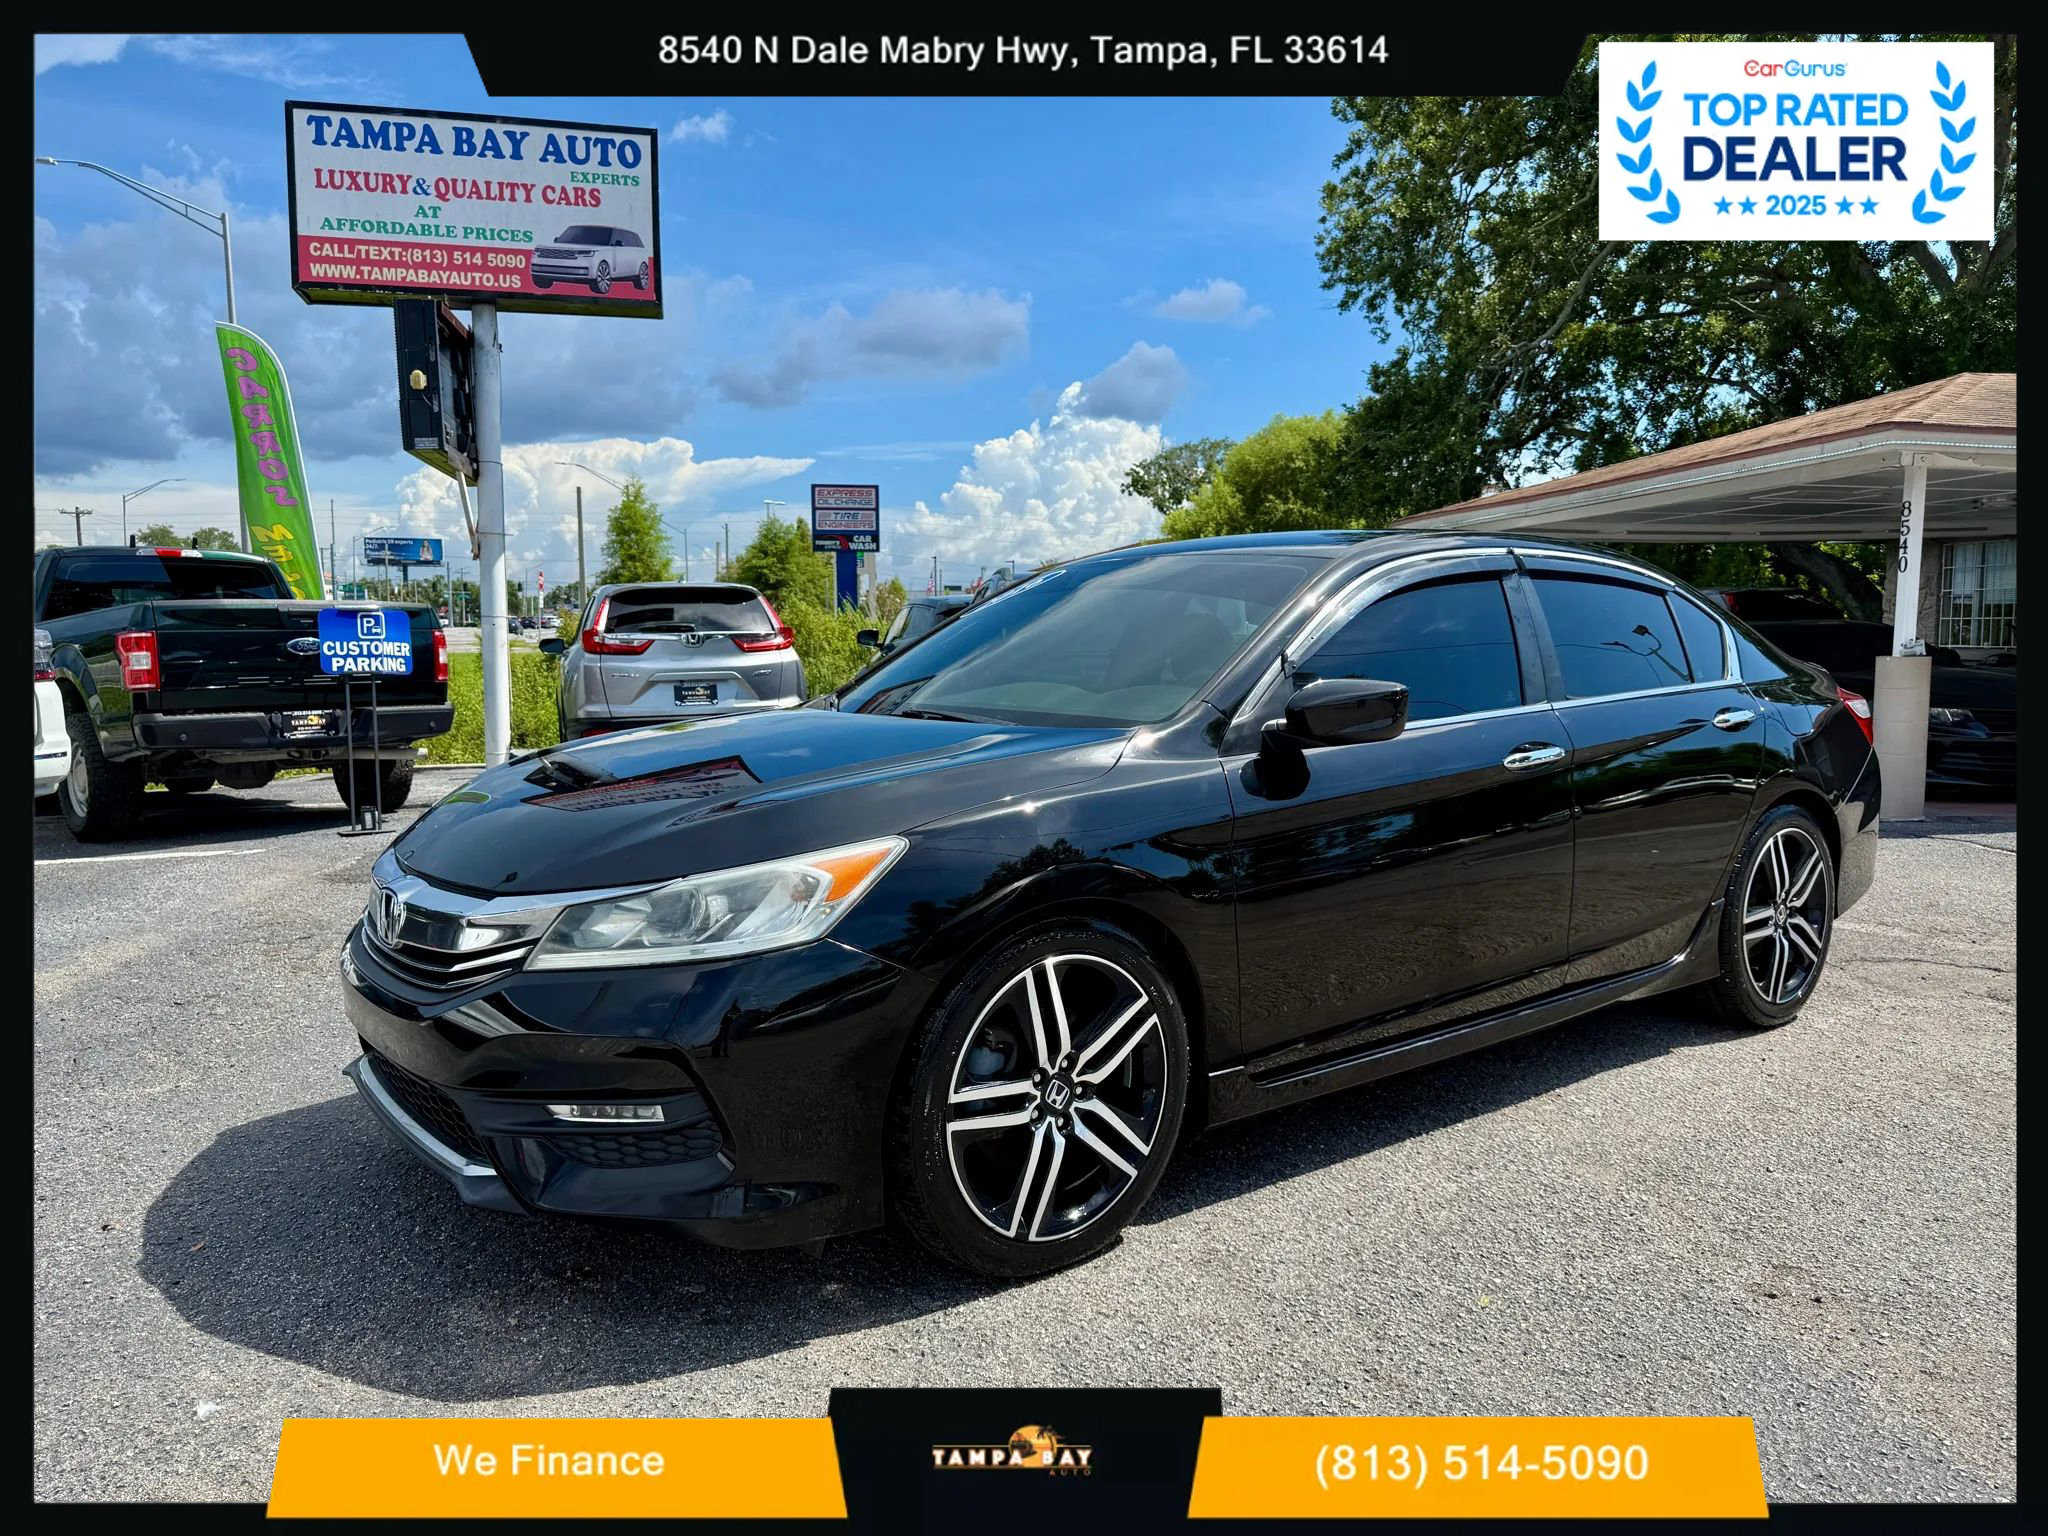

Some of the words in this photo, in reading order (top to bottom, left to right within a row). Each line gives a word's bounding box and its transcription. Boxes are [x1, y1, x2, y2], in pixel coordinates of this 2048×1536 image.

[306, 114, 444, 155] TAMPA
[452, 126, 530, 161] BAY
[539, 133, 642, 169] AUTO
[570, 171, 641, 187] EXPERTS
[541, 185, 602, 208] CARS
[414, 204, 442, 219] AT
[320, 217, 457, 238] AFFORDABLE
[462, 226, 534, 243] PRICES
[453, 251, 483, 267] 514
[487, 253, 526, 269] 5090
[309, 262, 522, 289] WWW.TAMPABAYAUTO.US
[817, 488, 873, 497] EXPRESS
[832, 512, 860, 520] TIRE
[818, 521, 874, 529] ENGINEERS
[1898, 500, 1912, 574] 8540
[848, 542, 877, 550] WASH
[322, 641, 411, 656] CUSTOMER
[331, 657, 407, 673] PARKING
